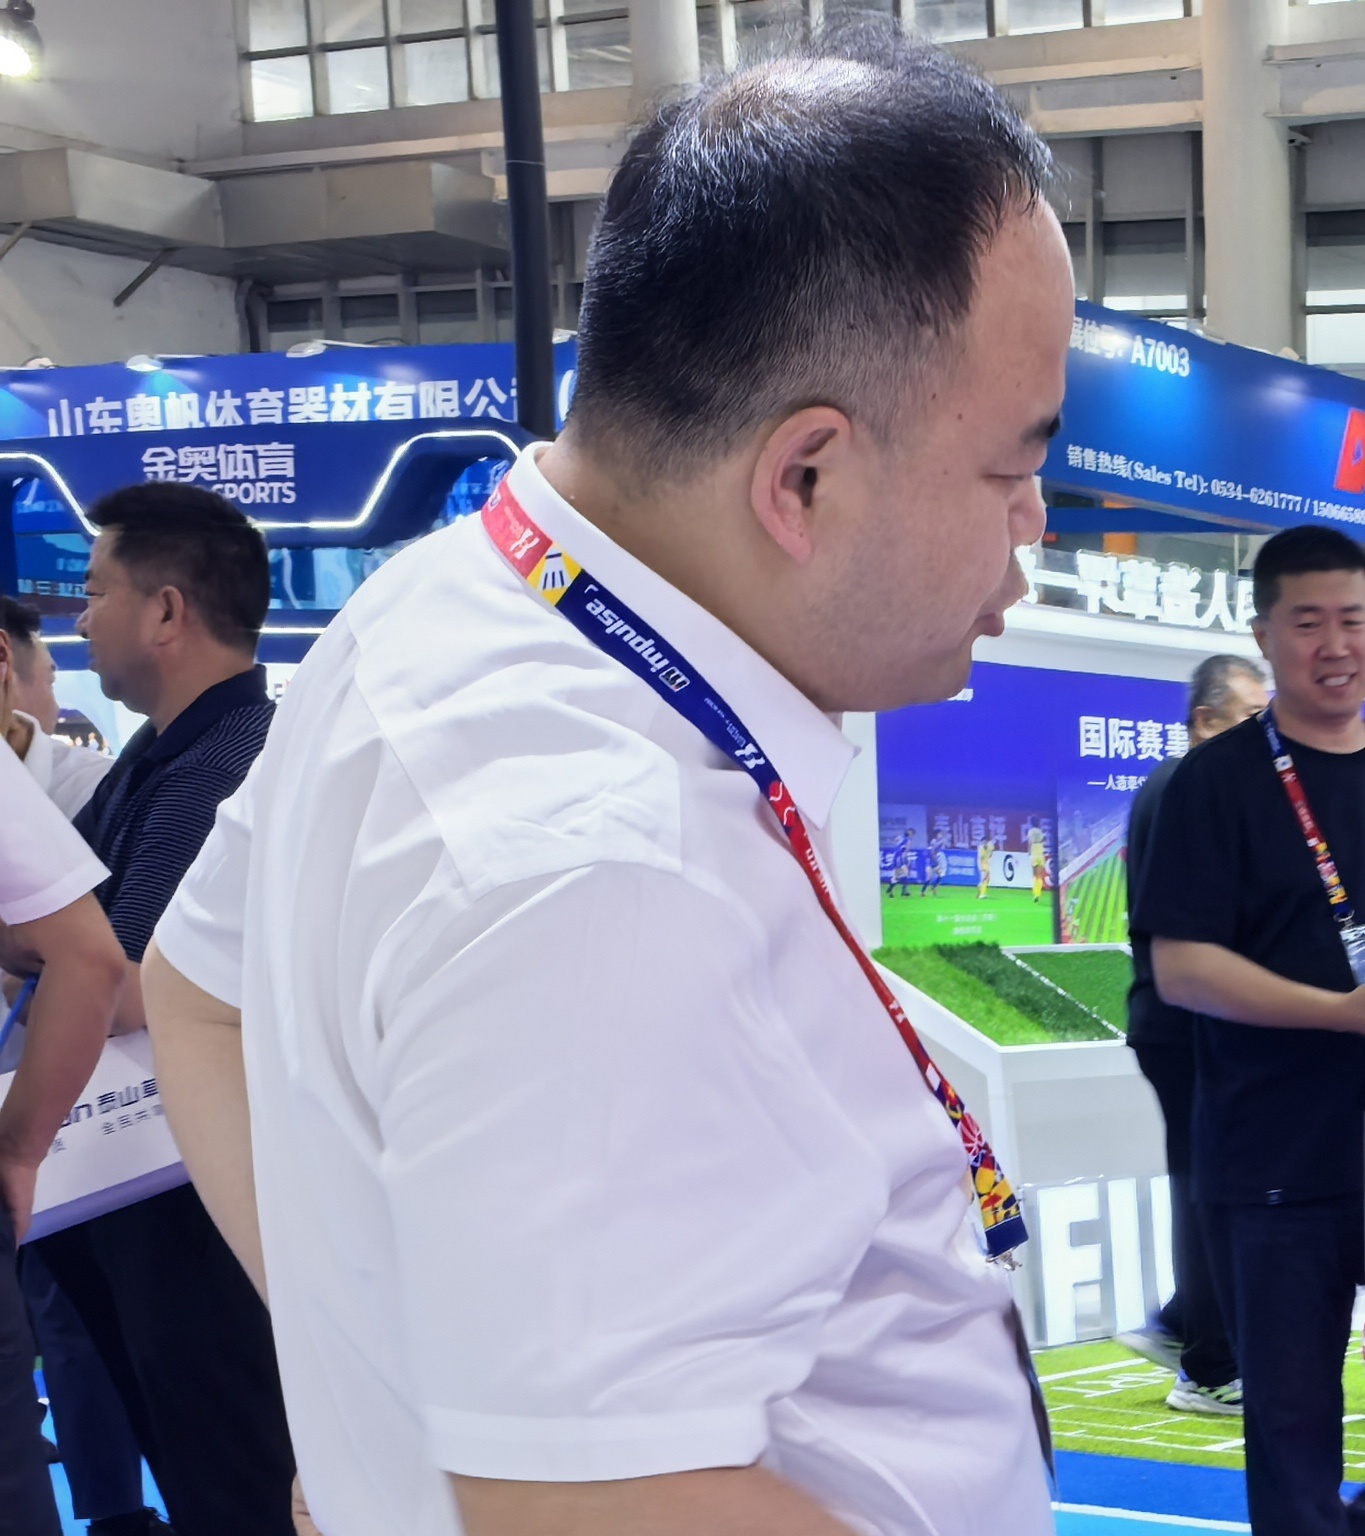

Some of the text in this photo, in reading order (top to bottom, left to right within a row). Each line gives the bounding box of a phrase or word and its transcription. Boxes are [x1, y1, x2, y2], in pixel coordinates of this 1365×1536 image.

[1130, 334, 1191, 378] A7003
[47, 376, 517, 438] 山东奥帆体育器材有限公
[140, 441, 296, 483] 金奥体育
[585, 598, 670, 674] impulse
[1079, 715, 1190, 761] 国际赛事
